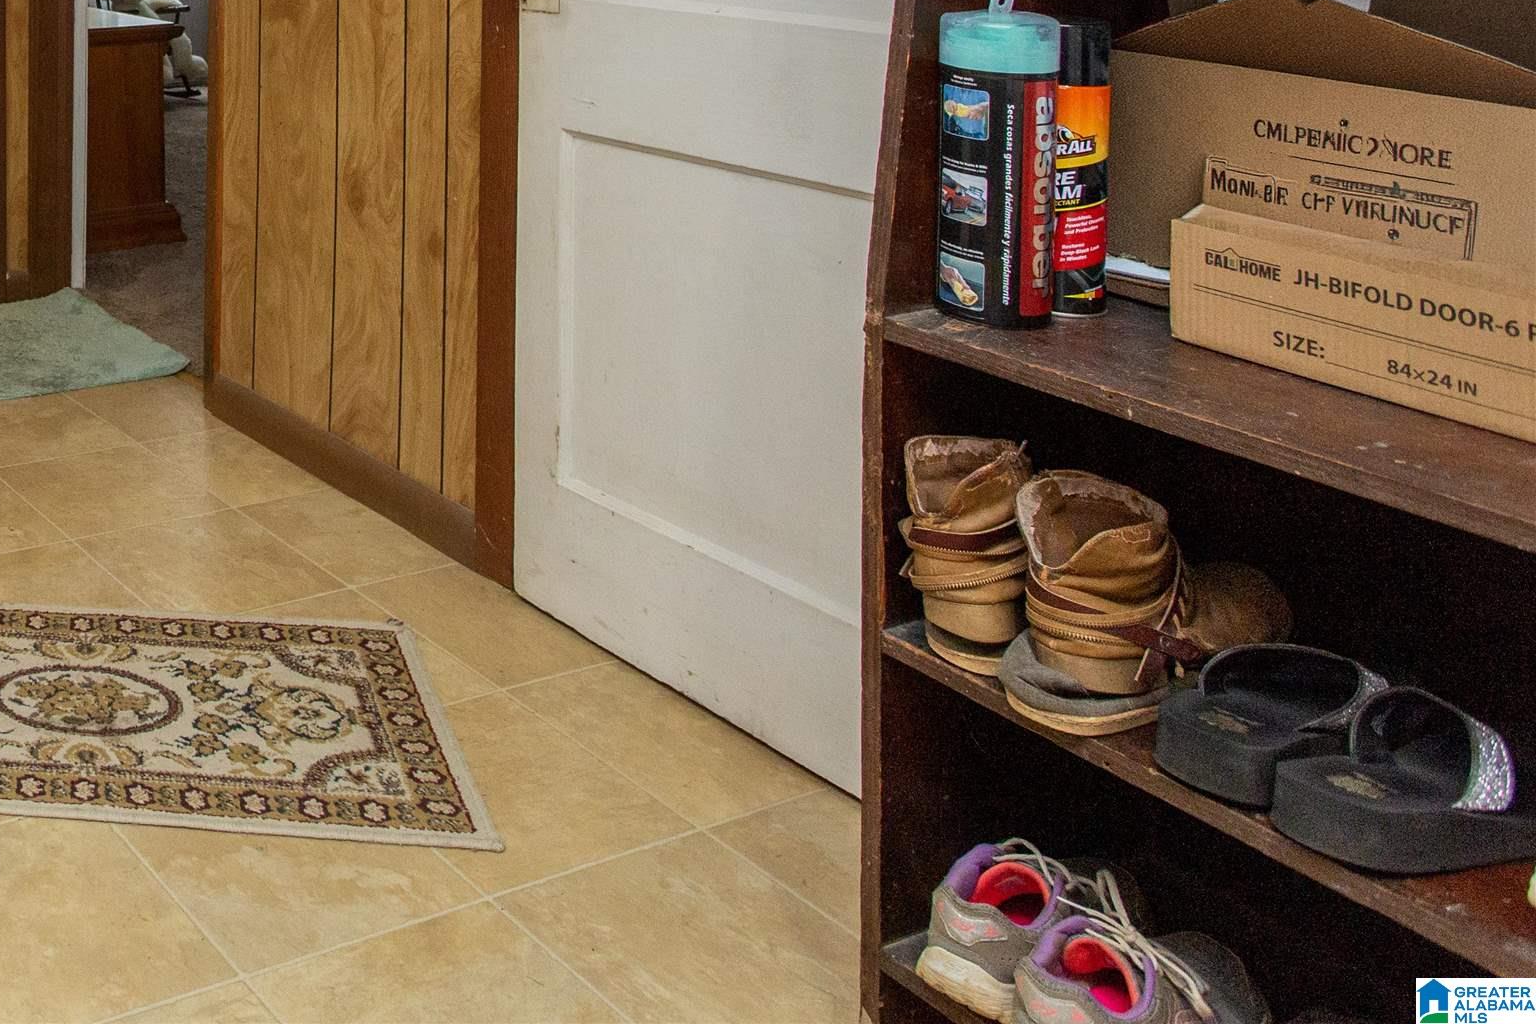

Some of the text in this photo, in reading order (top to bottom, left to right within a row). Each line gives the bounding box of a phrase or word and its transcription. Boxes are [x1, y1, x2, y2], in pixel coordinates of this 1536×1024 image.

[1293, 268, 1413, 312] JH-BIFOLD
[1420, 297, 1520, 339] DOOR-6
[1272, 329, 1326, 360] SIZE:
[1457, 379, 1478, 397] IN
